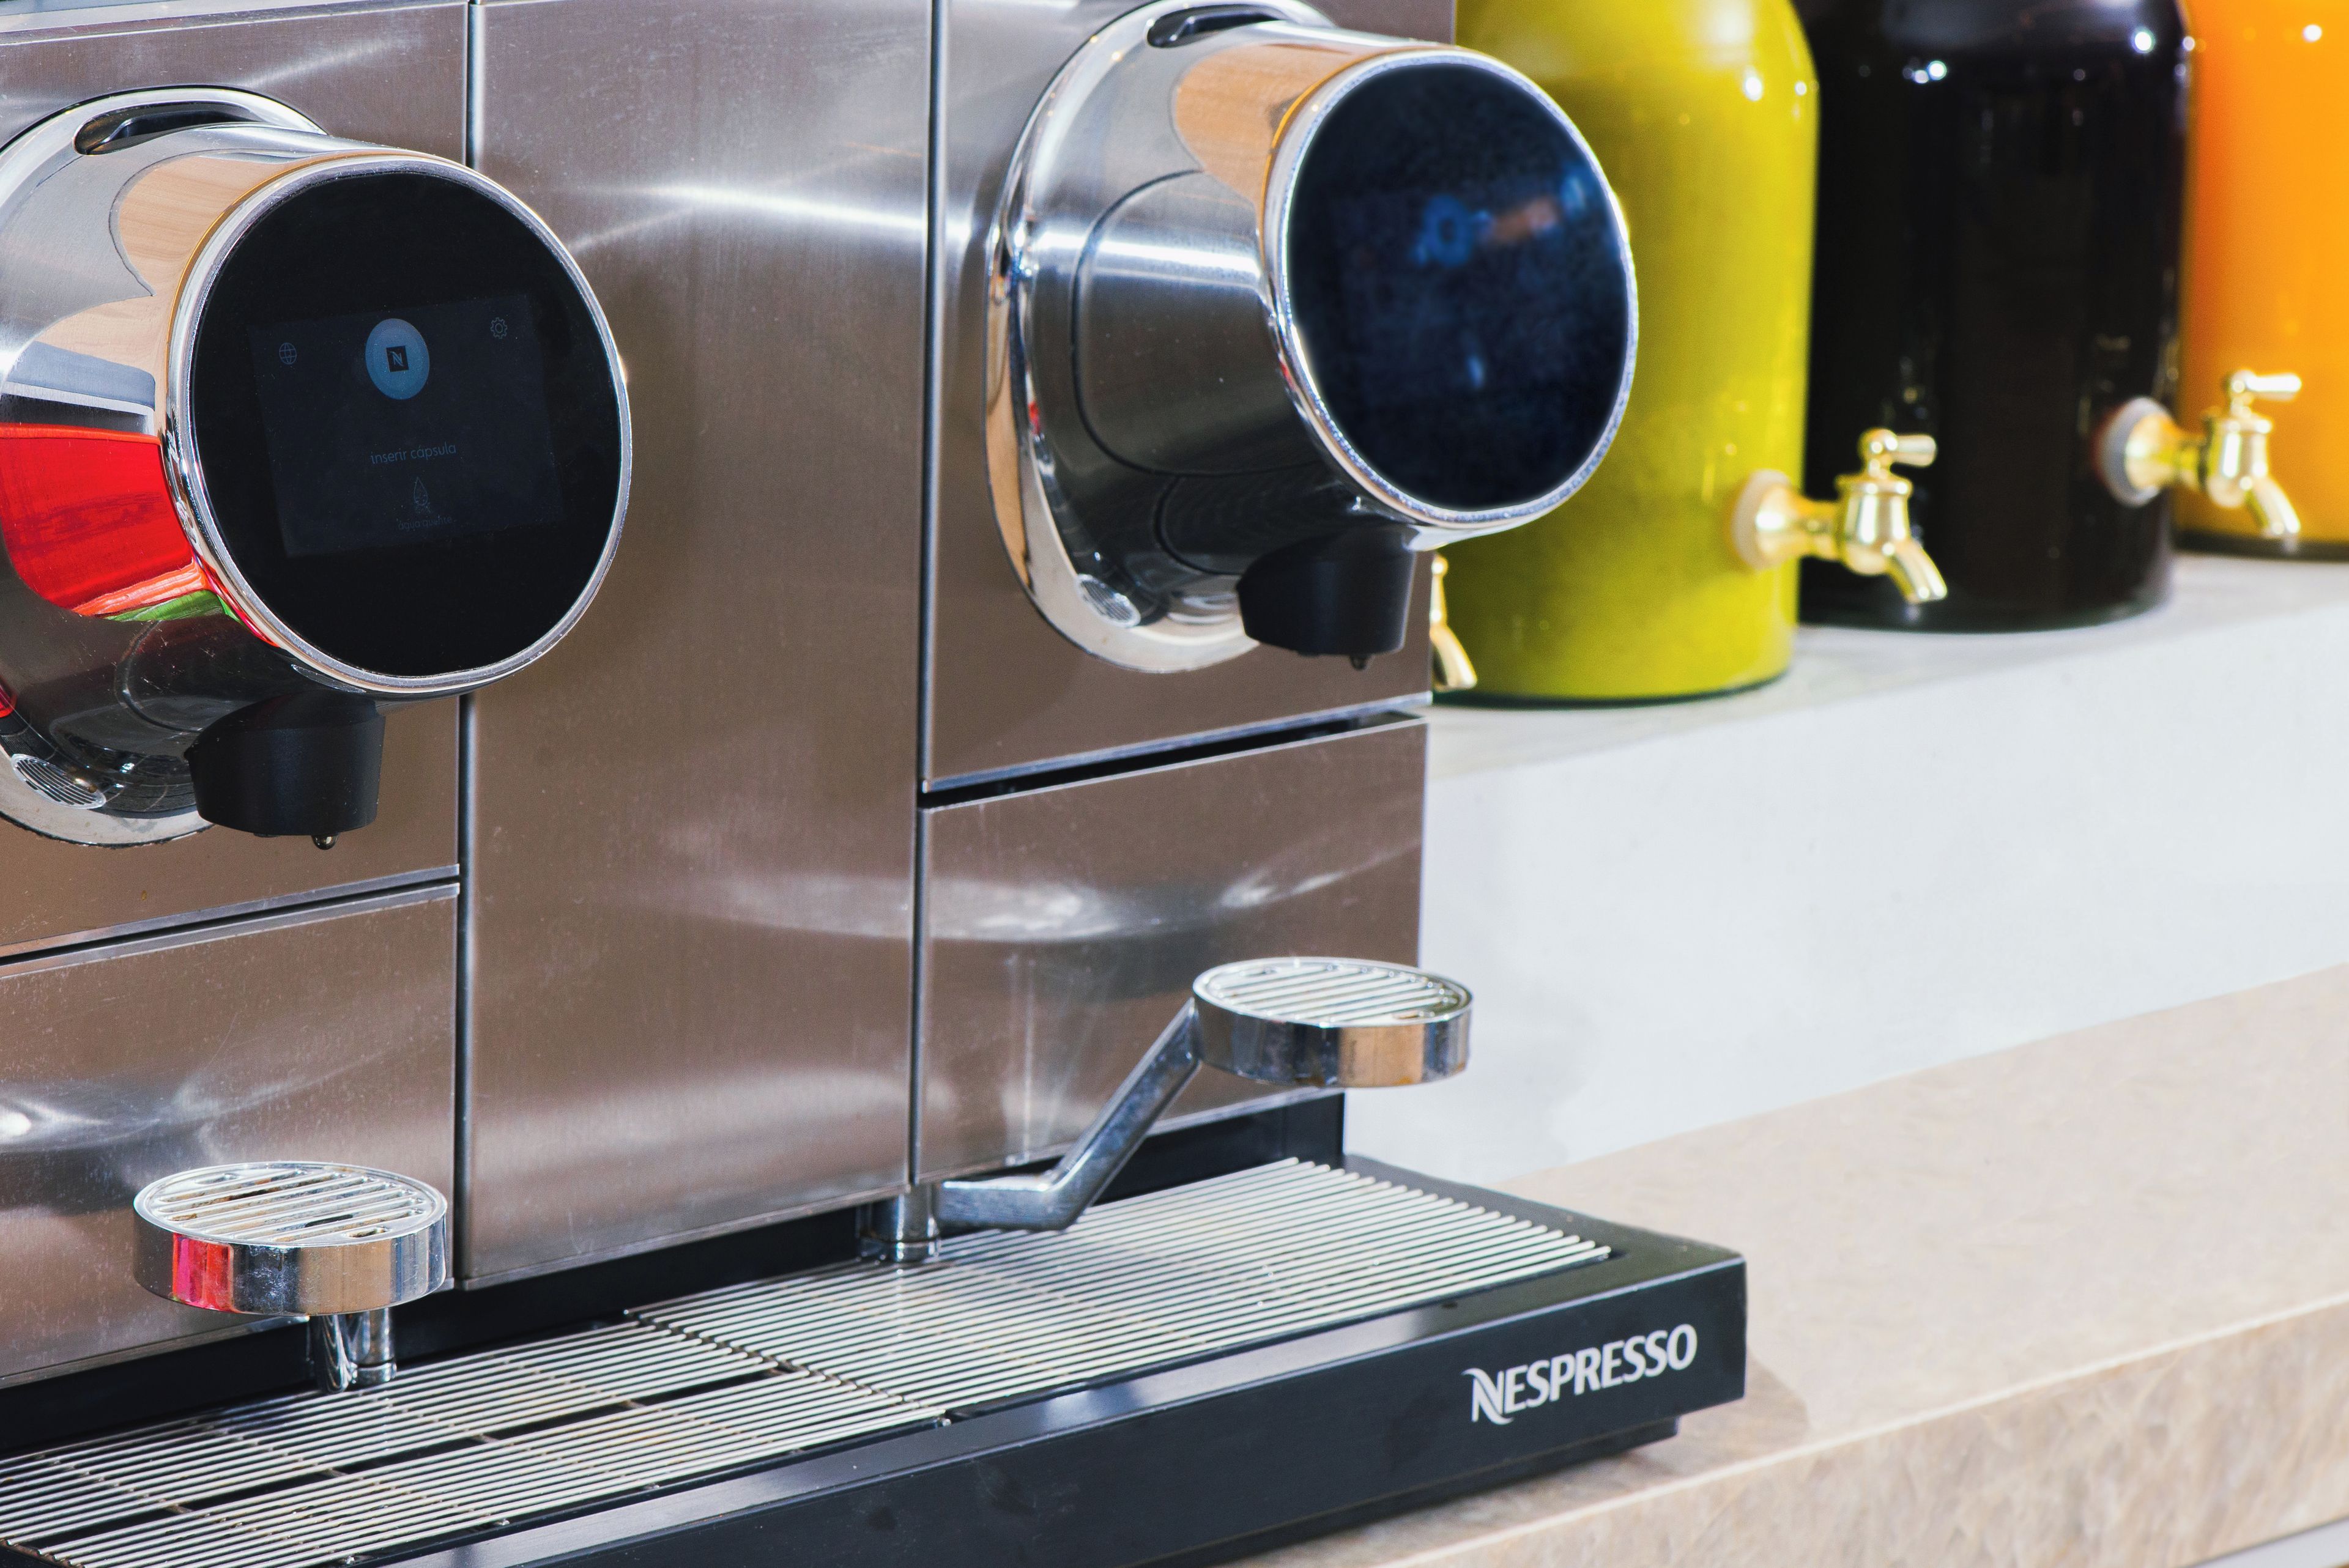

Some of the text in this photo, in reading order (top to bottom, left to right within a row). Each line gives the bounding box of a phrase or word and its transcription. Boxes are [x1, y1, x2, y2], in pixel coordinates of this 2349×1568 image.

[370, 441, 456, 464] inserir cápsula
[1461, 1323, 1698, 1425] NESPRESSO
